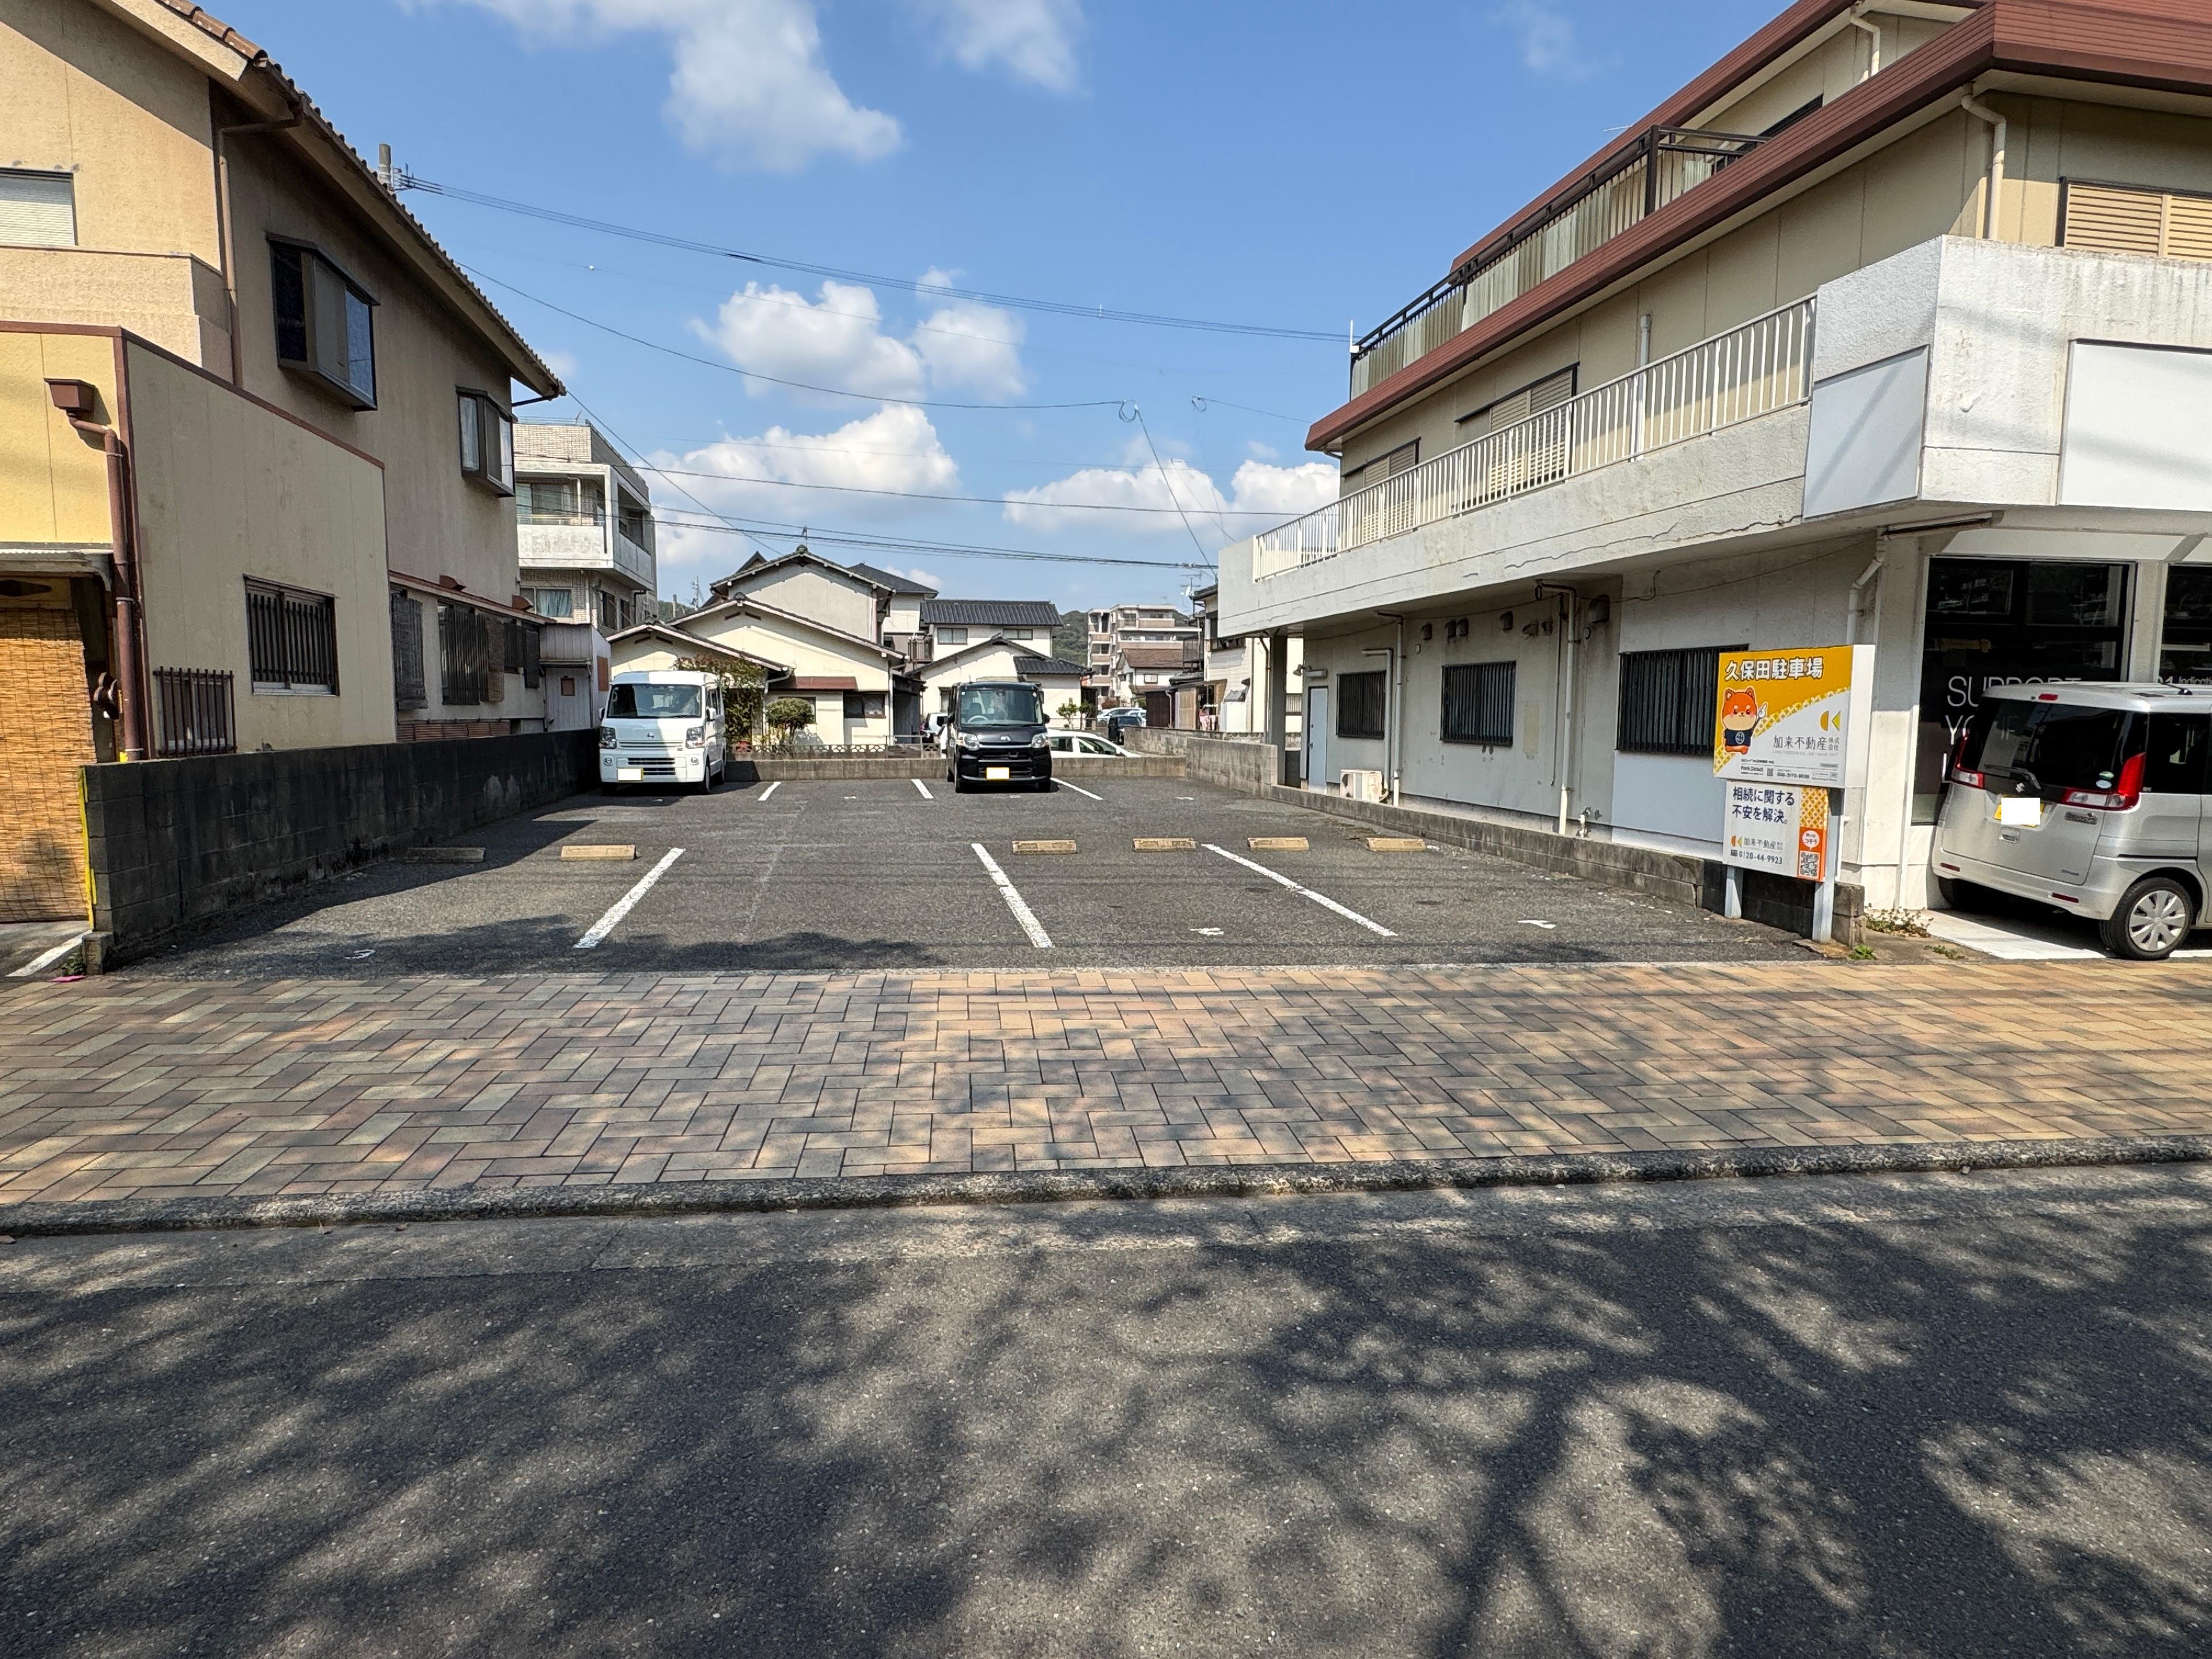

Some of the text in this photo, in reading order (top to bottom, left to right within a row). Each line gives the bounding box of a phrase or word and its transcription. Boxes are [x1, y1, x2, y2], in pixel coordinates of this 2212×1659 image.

[1725, 657, 1824, 681] 久保田駐車場
[1773, 734, 1827, 750] 加来不動産
[1733, 786, 1795, 806] 相続に関する
[1732, 805, 1788, 824] 不安を解決。
